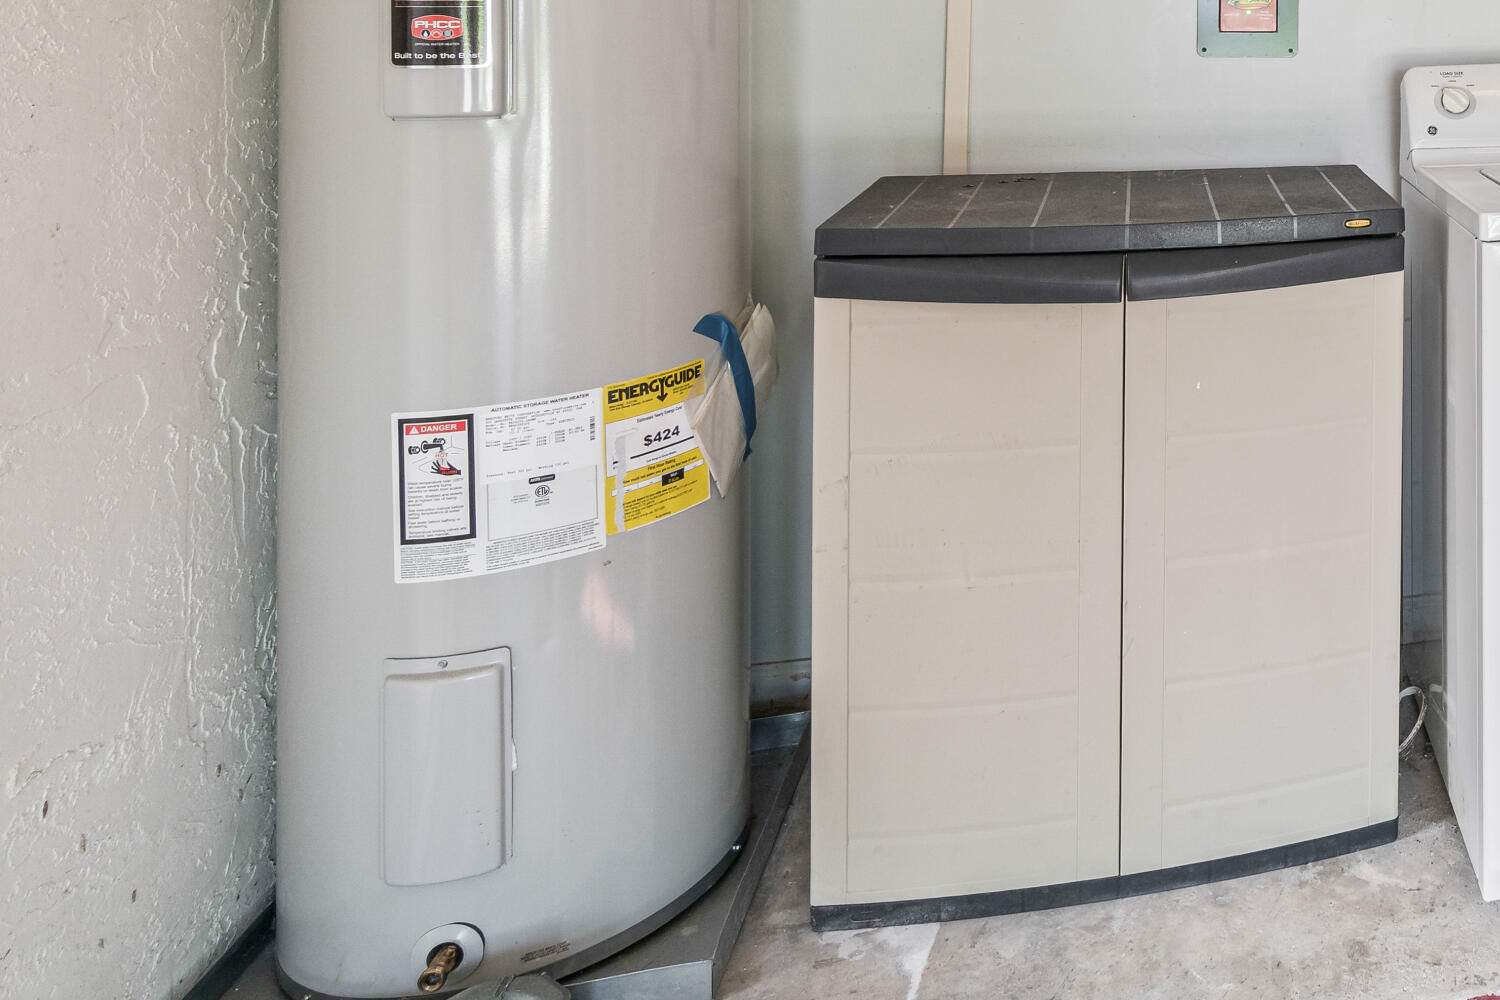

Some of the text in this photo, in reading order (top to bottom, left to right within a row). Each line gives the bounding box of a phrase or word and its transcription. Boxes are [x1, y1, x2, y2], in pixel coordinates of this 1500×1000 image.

[413, 20, 462, 30] PHCC
[607, 364, 702, 404] ENERGYGUIDE
[491, 404, 522, 413] AUTOMATIC
[523, 400, 549, 408] STORAGE
[550, 396, 569, 404] WATER
[420, 423, 457, 433] DANGER
[643, 425, 680, 447] $424
